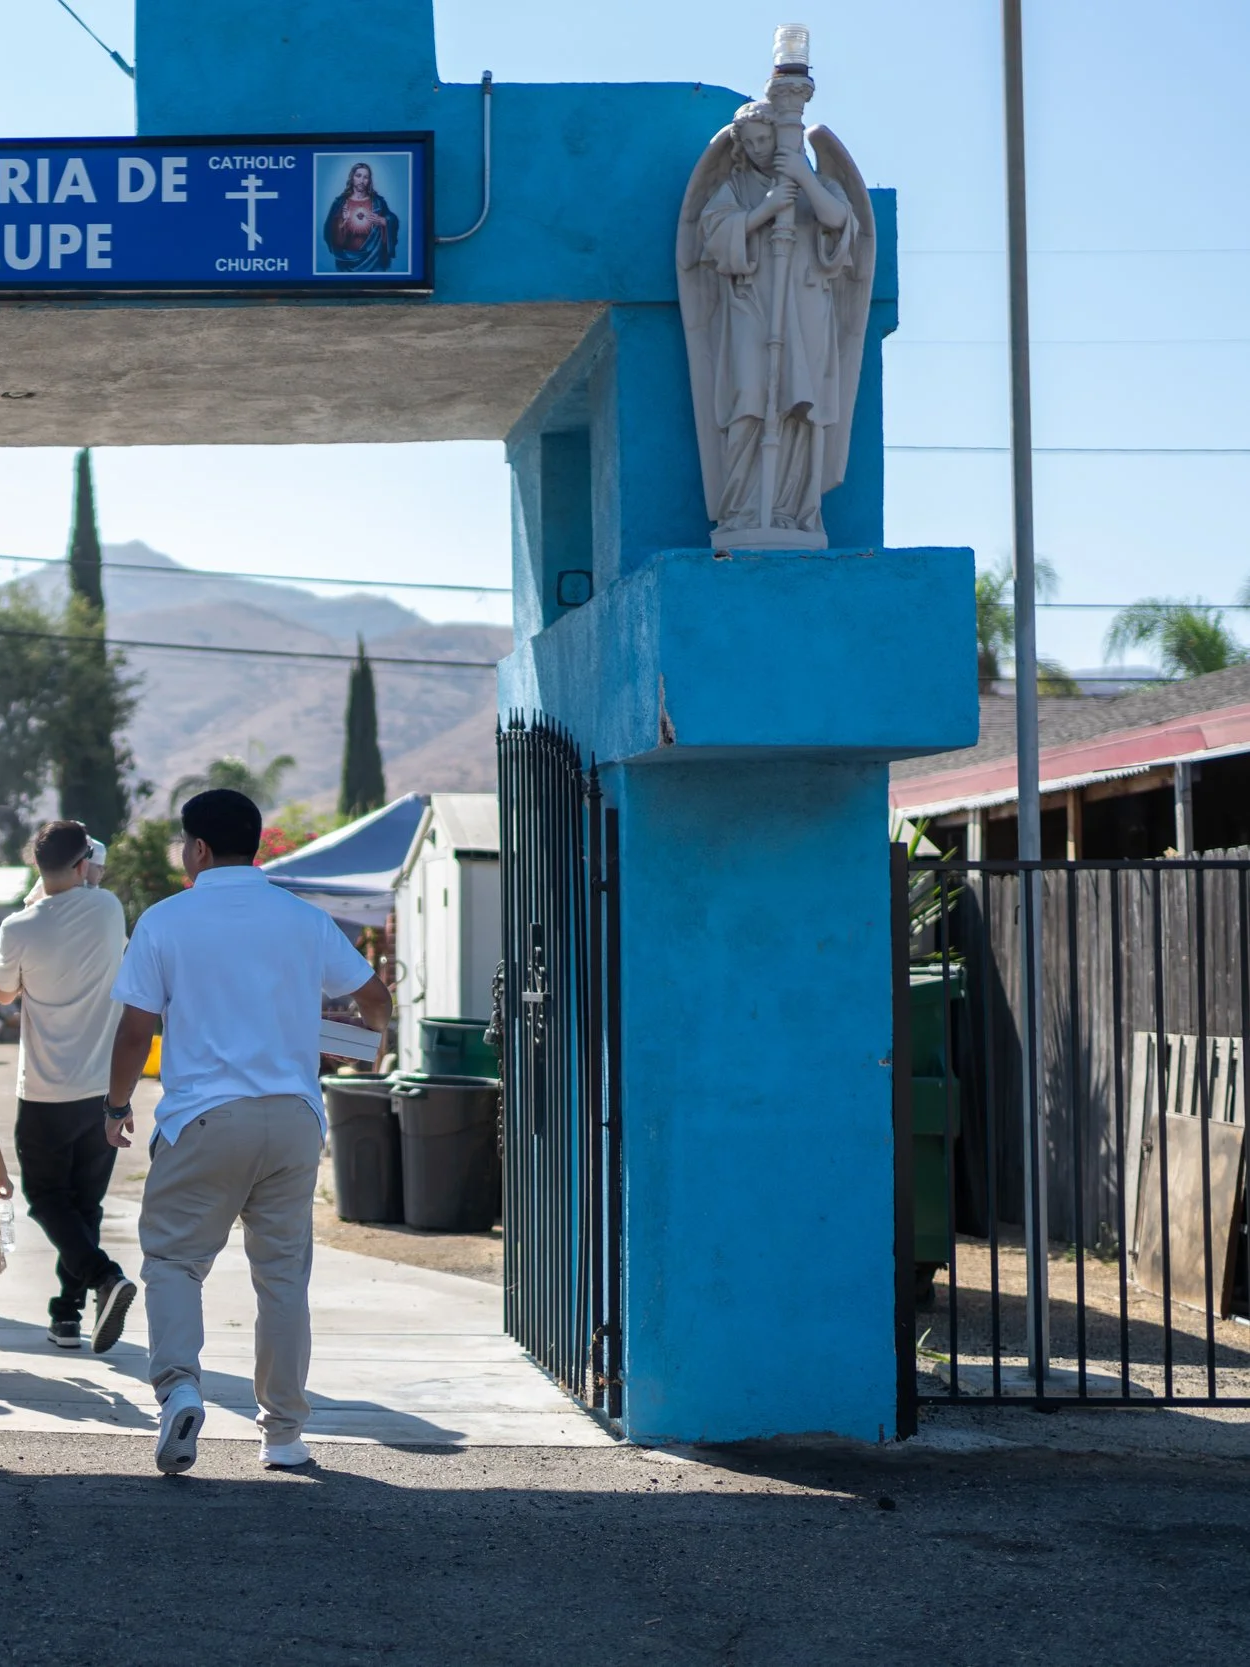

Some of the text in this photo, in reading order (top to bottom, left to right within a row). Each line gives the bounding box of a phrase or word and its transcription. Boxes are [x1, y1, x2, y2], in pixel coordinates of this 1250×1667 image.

[207, 155, 297, 170] CATHOLIC
[118, 156, 189, 203] DE
[215, 257, 289, 272] CHURCH
